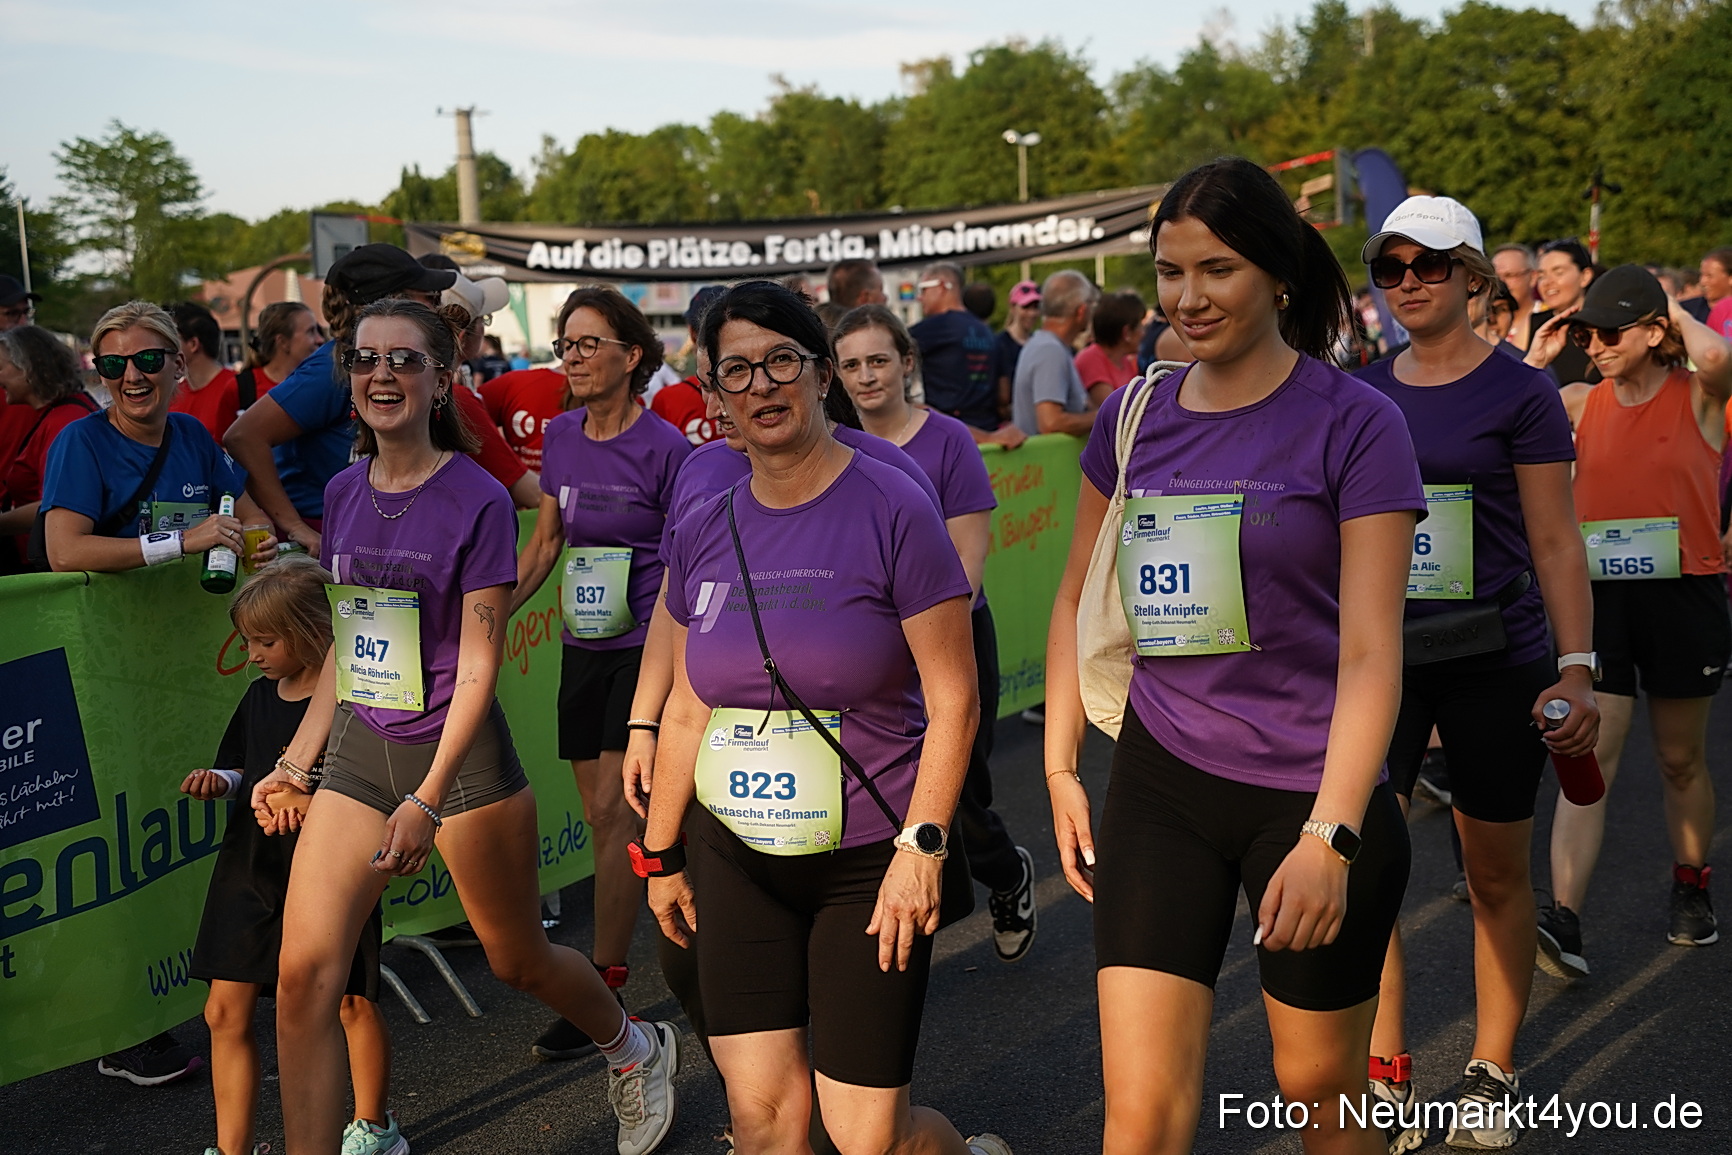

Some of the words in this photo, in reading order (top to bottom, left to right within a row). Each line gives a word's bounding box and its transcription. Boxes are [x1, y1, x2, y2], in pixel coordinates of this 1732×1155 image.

[1416, 212, 1444, 223] Sport
[526, 239, 584, 269] Auf
[589, 237, 644, 269] die
[648, 236, 761, 268] Plätze.
[878, 214, 1105, 258] Miteinander.
[1169, 478, 1286, 492] EVANGELISCH-LUERISCHER
[1133, 526, 1172, 539] Firmenlauf
[1420, 562, 1441, 571] Alic
[1599, 556, 1654, 575] 1565
[736, 568, 835, 581] EVNGELISCH-LUTHERISCHER
[1140, 563, 1190, 595] 831
[576, 586, 605, 604] 837
[731, 582, 813, 598] Deanatsbezirk
[574, 608, 595, 617] Sabrina
[596, 608, 613, 617] Matz
[1133, 604, 1160, 617] Stella
[1163, 603, 1209, 618] Knipfer
[355, 635, 389, 662] 847
[350, 664, 367, 675] Alicia
[368, 666, 401, 681] Röhrlich
[2, 718, 42, 750] er
[727, 739, 770, 747] Firmenlauf
[729, 770, 797, 800] 823
[36, 785, 76, 812] mit!
[708, 803, 765, 820] Natascha
[767, 808, 828, 820] Feßmann
